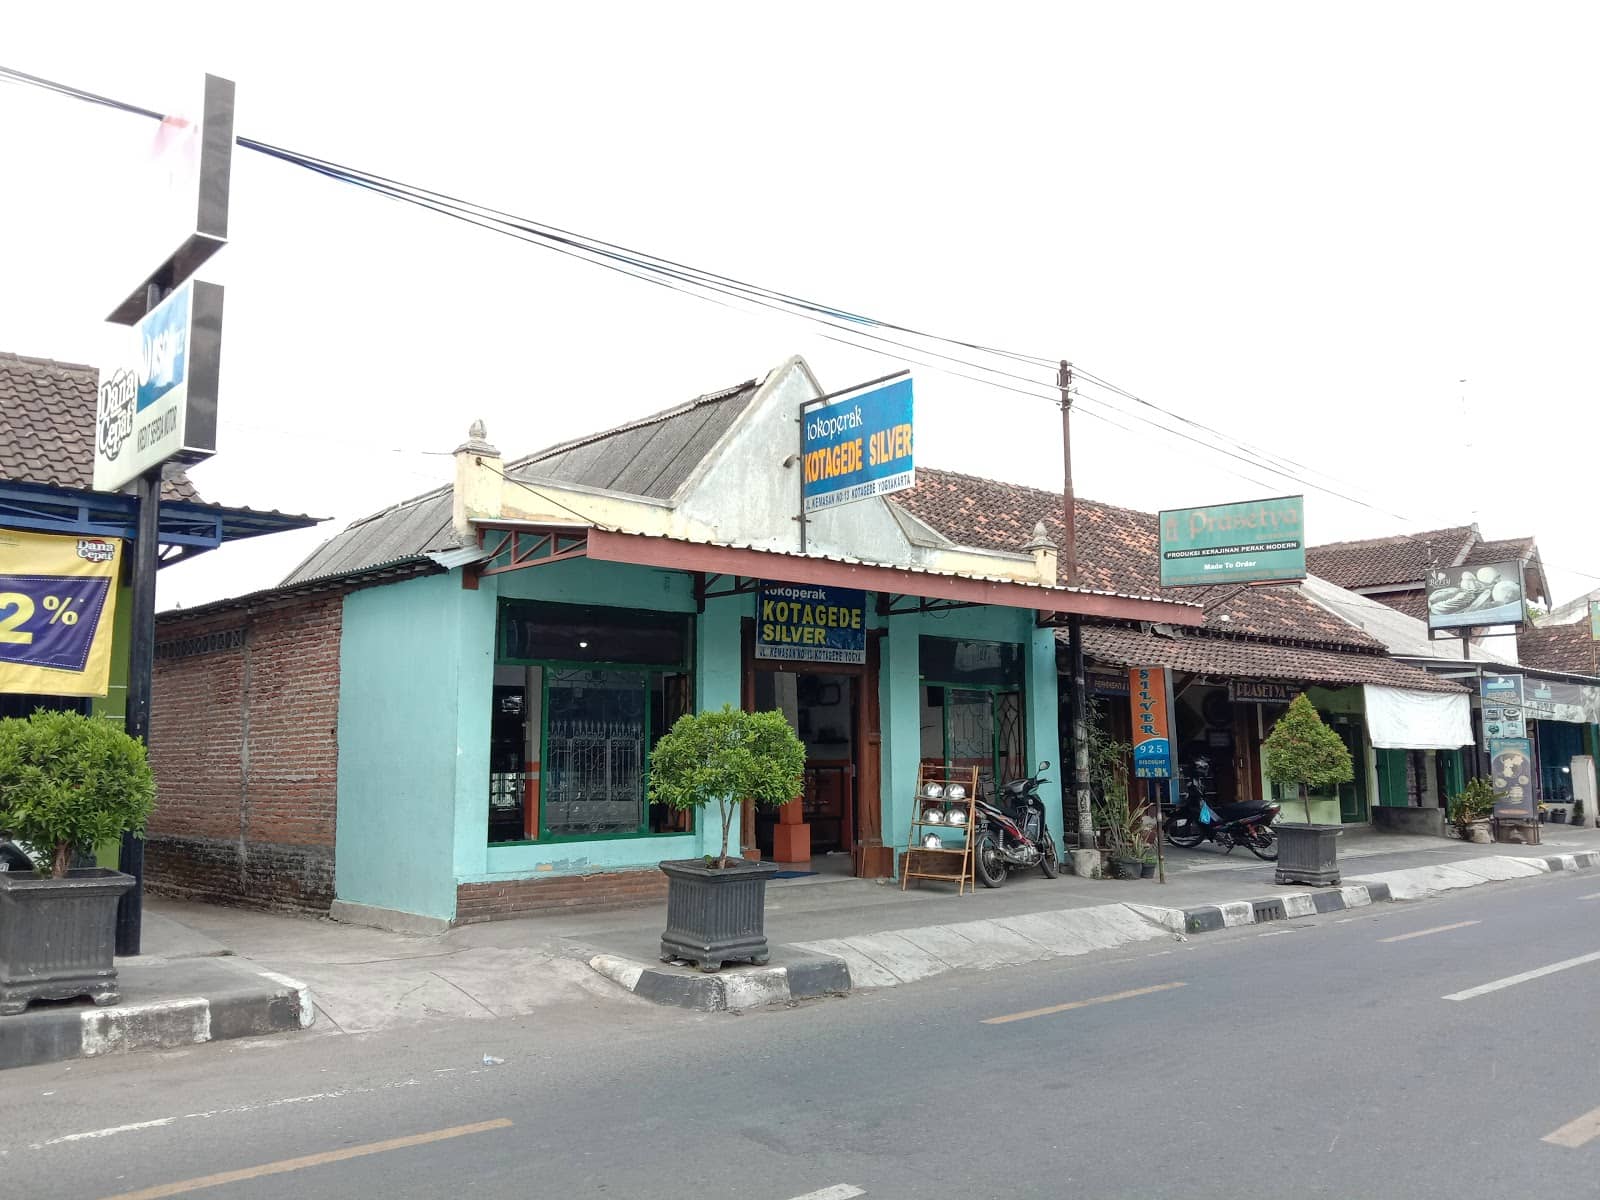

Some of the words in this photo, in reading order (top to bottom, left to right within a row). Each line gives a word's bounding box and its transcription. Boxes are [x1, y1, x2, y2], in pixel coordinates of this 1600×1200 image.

[100, 371, 136, 417] Dana
[99, 407, 135, 457] Cepat
[807, 404, 863, 441] tokoperak
[804, 438, 863, 484] KOTAGEDE
[869, 423, 913, 466] SILVER
[812, 495, 835, 509] KEMASAN
[851, 483, 876, 498] KOTAGEDE
[878, 474, 911, 493] YOGYAKARTA
[1189, 507, 1298, 540] Prasetya
[77, 539, 114, 552] Dana
[77, 549, 114, 562] Cepat
[1167, 550, 1201, 559] PRODUKSI
[1201, 546, 1240, 556] KERAJINAN
[1241, 544, 1265, 552] PERAK
[1266, 541, 1298, 551] MODERN
[1203, 563, 1223, 571] Made
[1225, 561, 1234, 569] To
[1235, 560, 1257, 568] Order
[762, 600, 861, 630] KOTAGEDE
[762, 623, 827, 645] SILVER
[845, 651, 861, 662] YOGYA
[1139, 669, 1160, 736] SILVER
[1236, 681, 1287, 698] PRASETYA
[1139, 744, 1164, 754] 925
